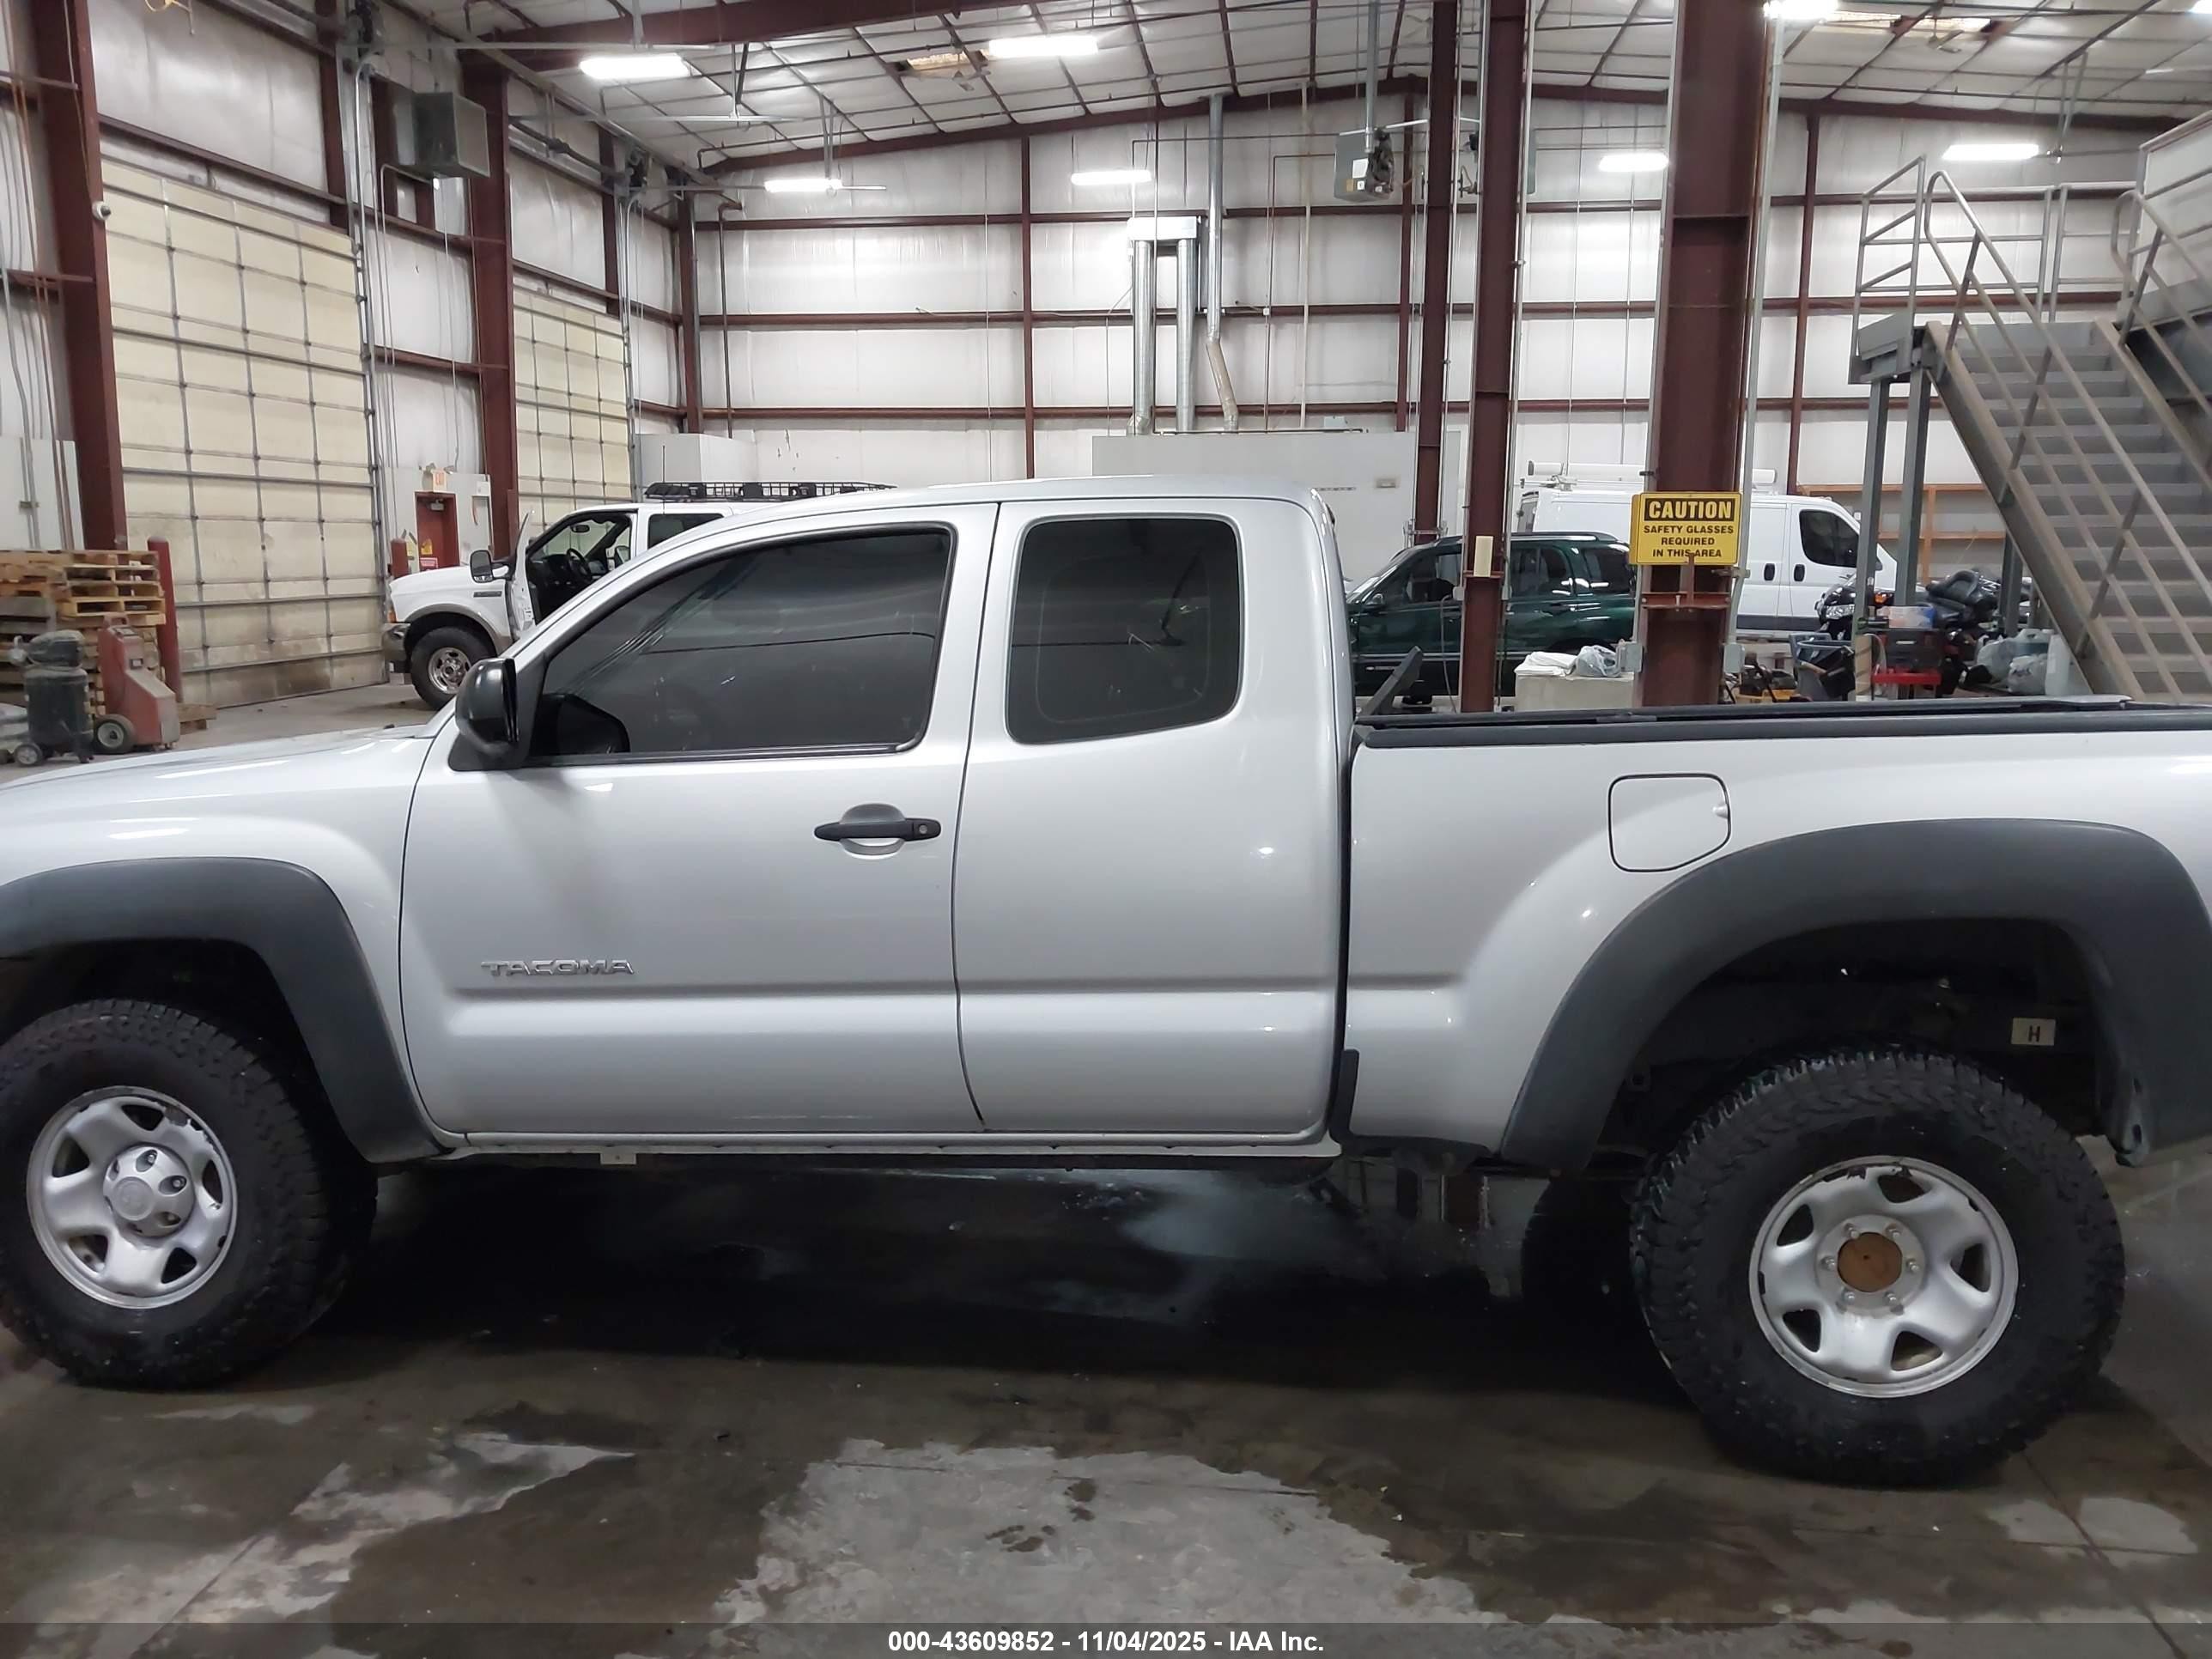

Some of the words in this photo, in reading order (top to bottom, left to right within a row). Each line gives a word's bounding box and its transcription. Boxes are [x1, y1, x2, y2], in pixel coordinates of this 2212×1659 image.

[1649, 501, 1732, 519] CAUTION
[1661, 537, 1715, 545] REQUIRED
[1652, 549, 1664, 557] IN
[1667, 549, 1692, 557] THIS
[1694, 549, 1722, 557] AREA
[481, 959, 635, 976] TACOMA
[2028, 1025, 2040, 1042] H
